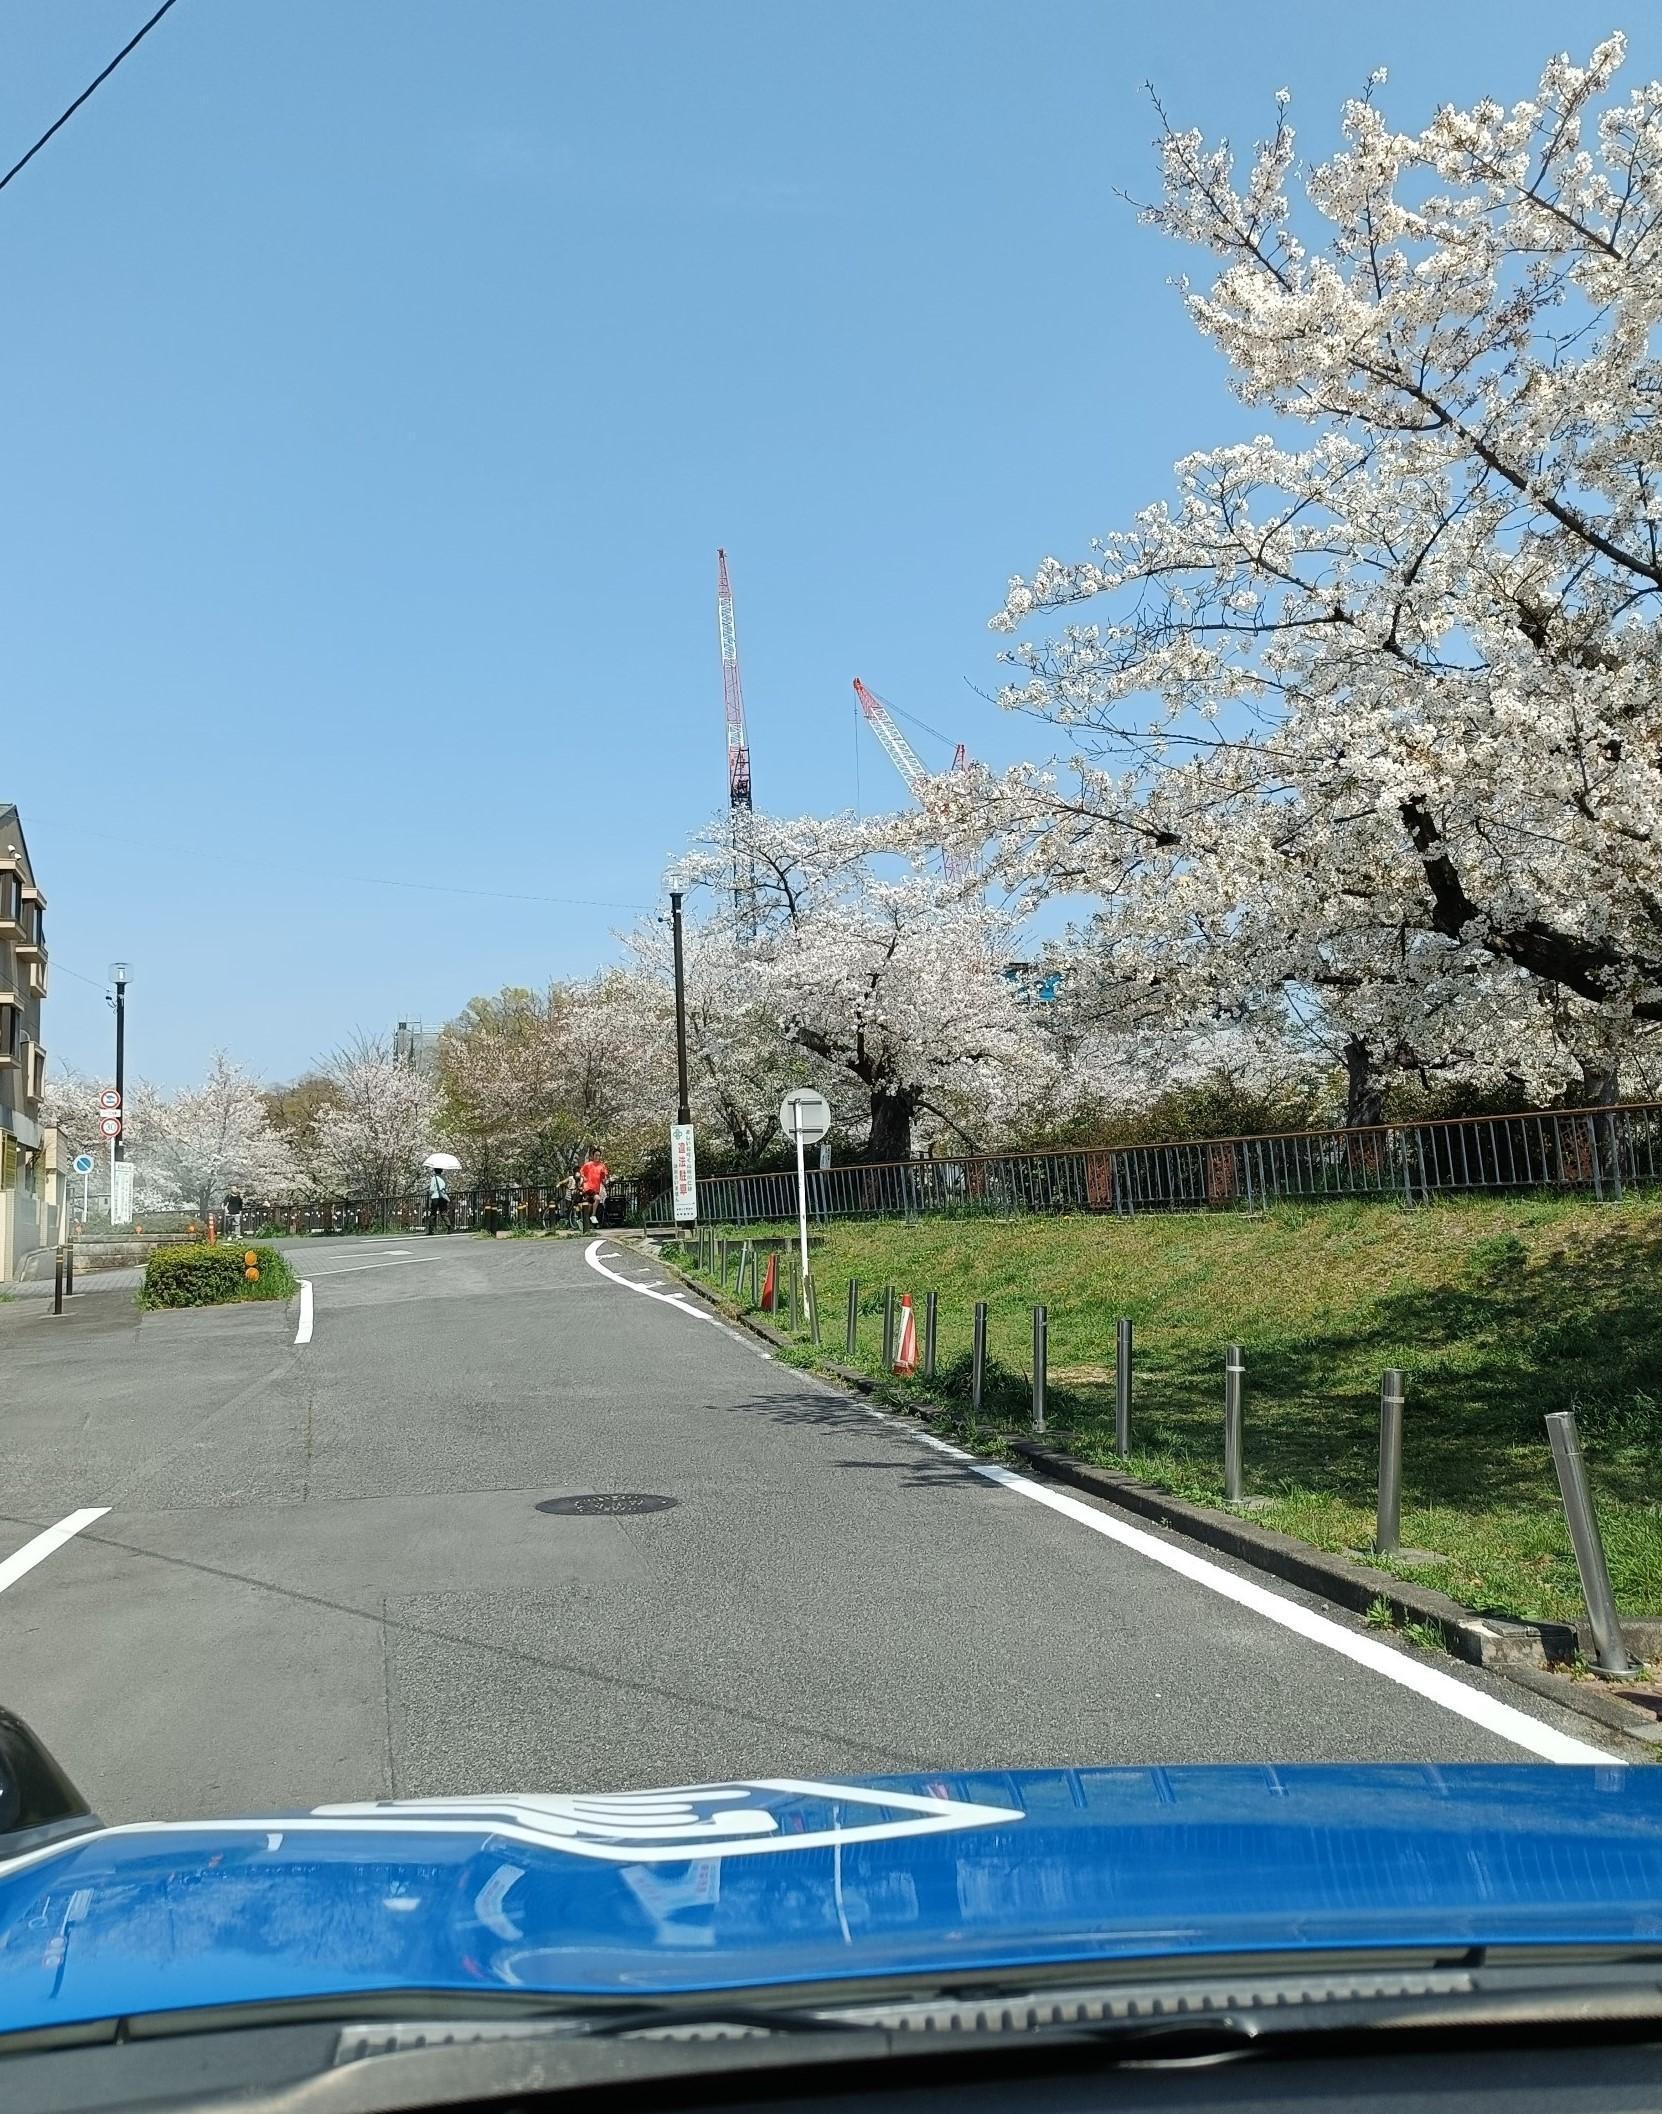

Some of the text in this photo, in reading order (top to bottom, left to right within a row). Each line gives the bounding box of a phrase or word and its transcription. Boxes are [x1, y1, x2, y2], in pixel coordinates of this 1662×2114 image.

[105, 1122, 116, 1132] 30
[678, 1142, 687, 1196] 違法駐車
